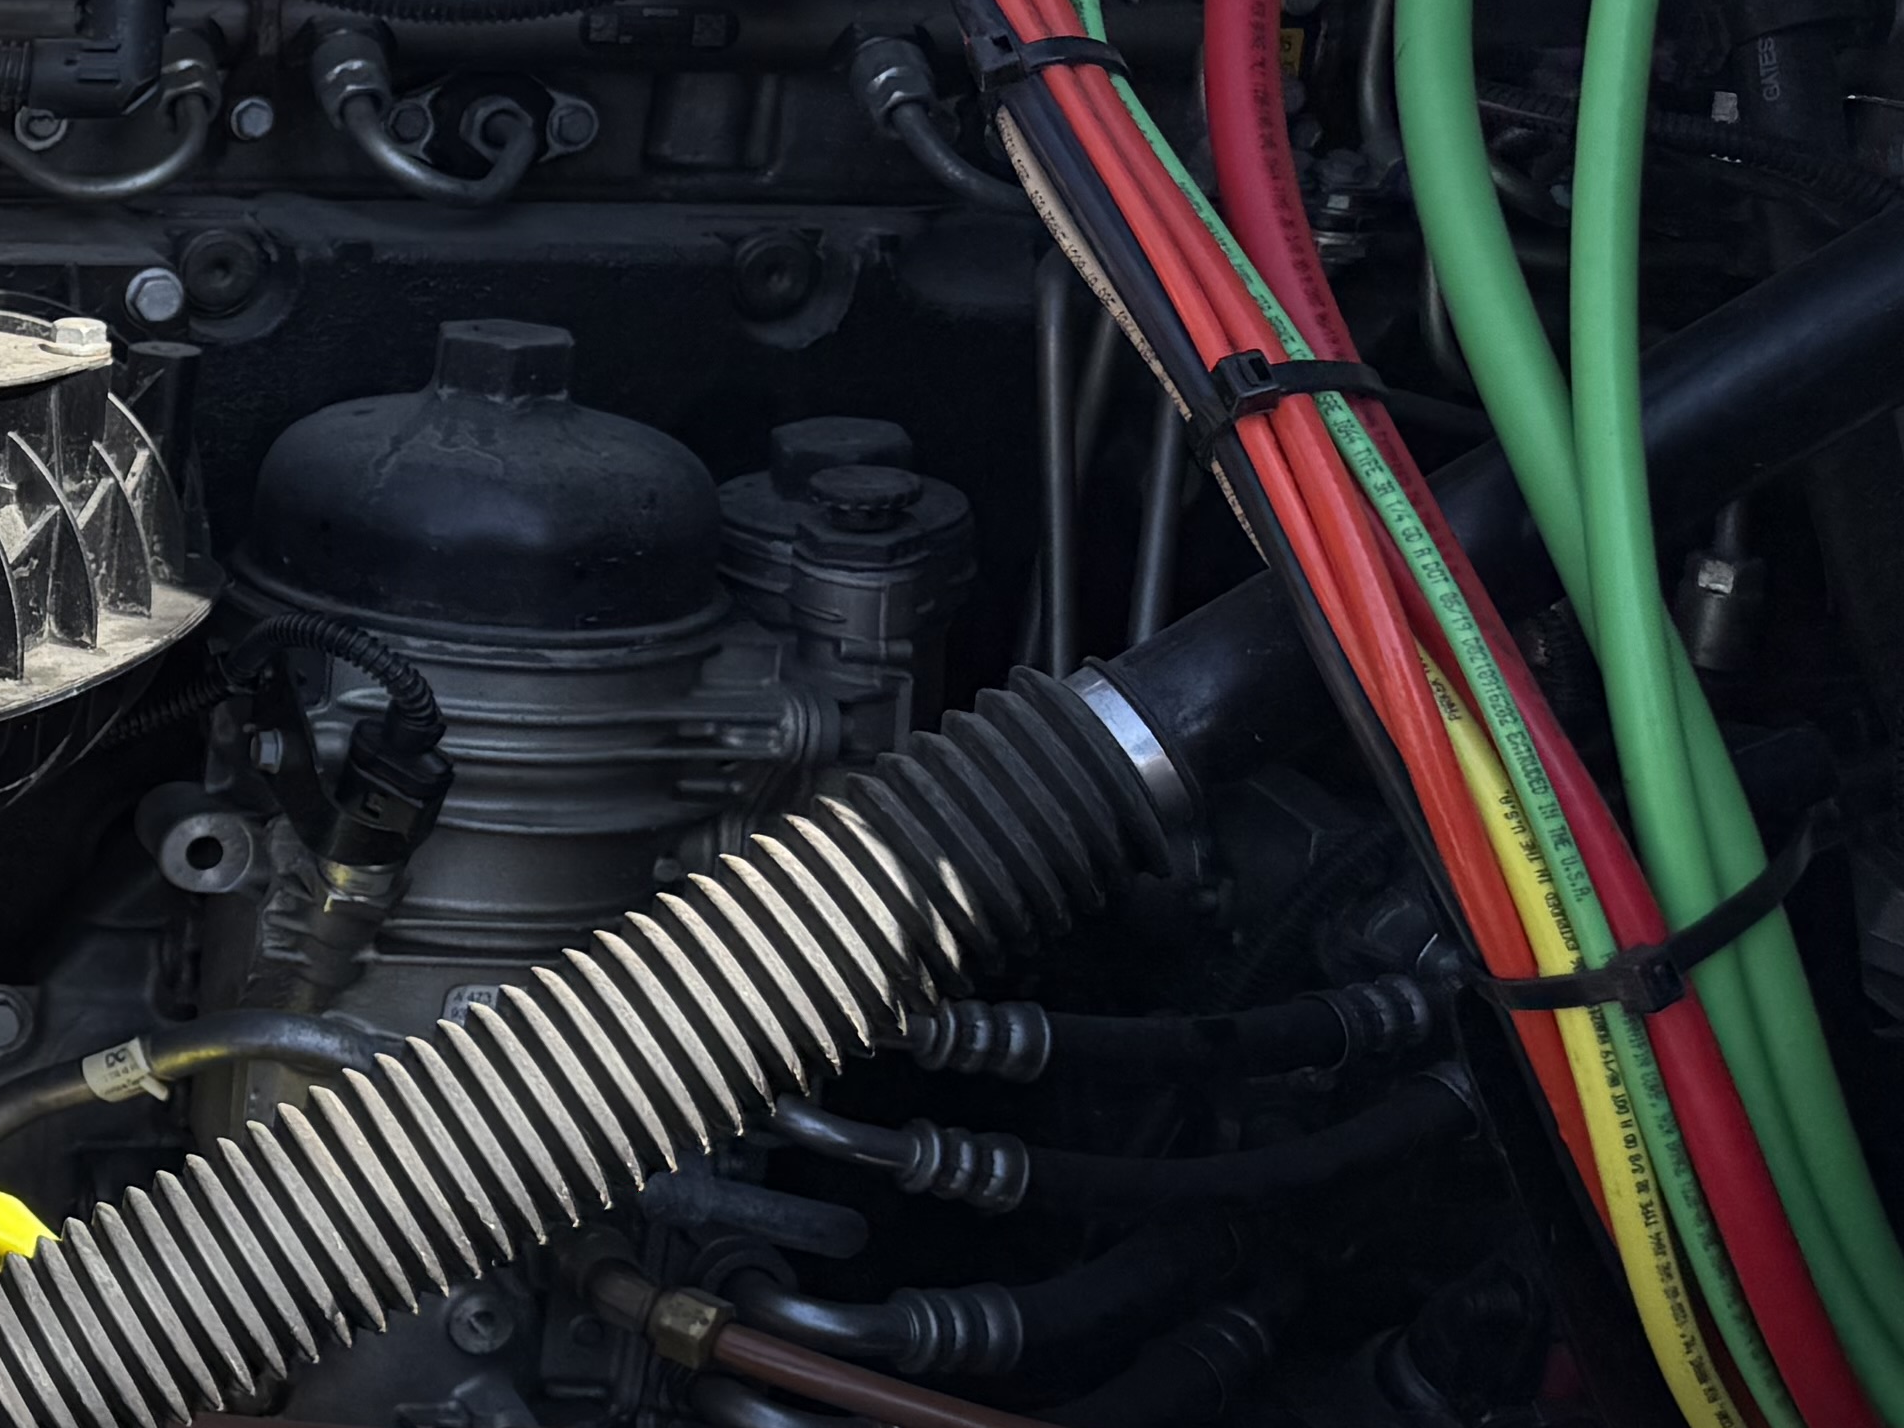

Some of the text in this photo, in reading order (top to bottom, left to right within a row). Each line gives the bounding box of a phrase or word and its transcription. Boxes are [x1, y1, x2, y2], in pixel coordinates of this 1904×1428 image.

[1756, 35, 1781, 101] GATES
[1315, 392, 1342, 419] SAE
[1353, 444, 1385, 480] TYPE
[1557, 853, 1594, 904] U.S.A.
[1494, 787, 1528, 837] U.S.A.
[1517, 836, 1542, 865] THE
[1542, 889, 1580, 954] EXTRUDED
